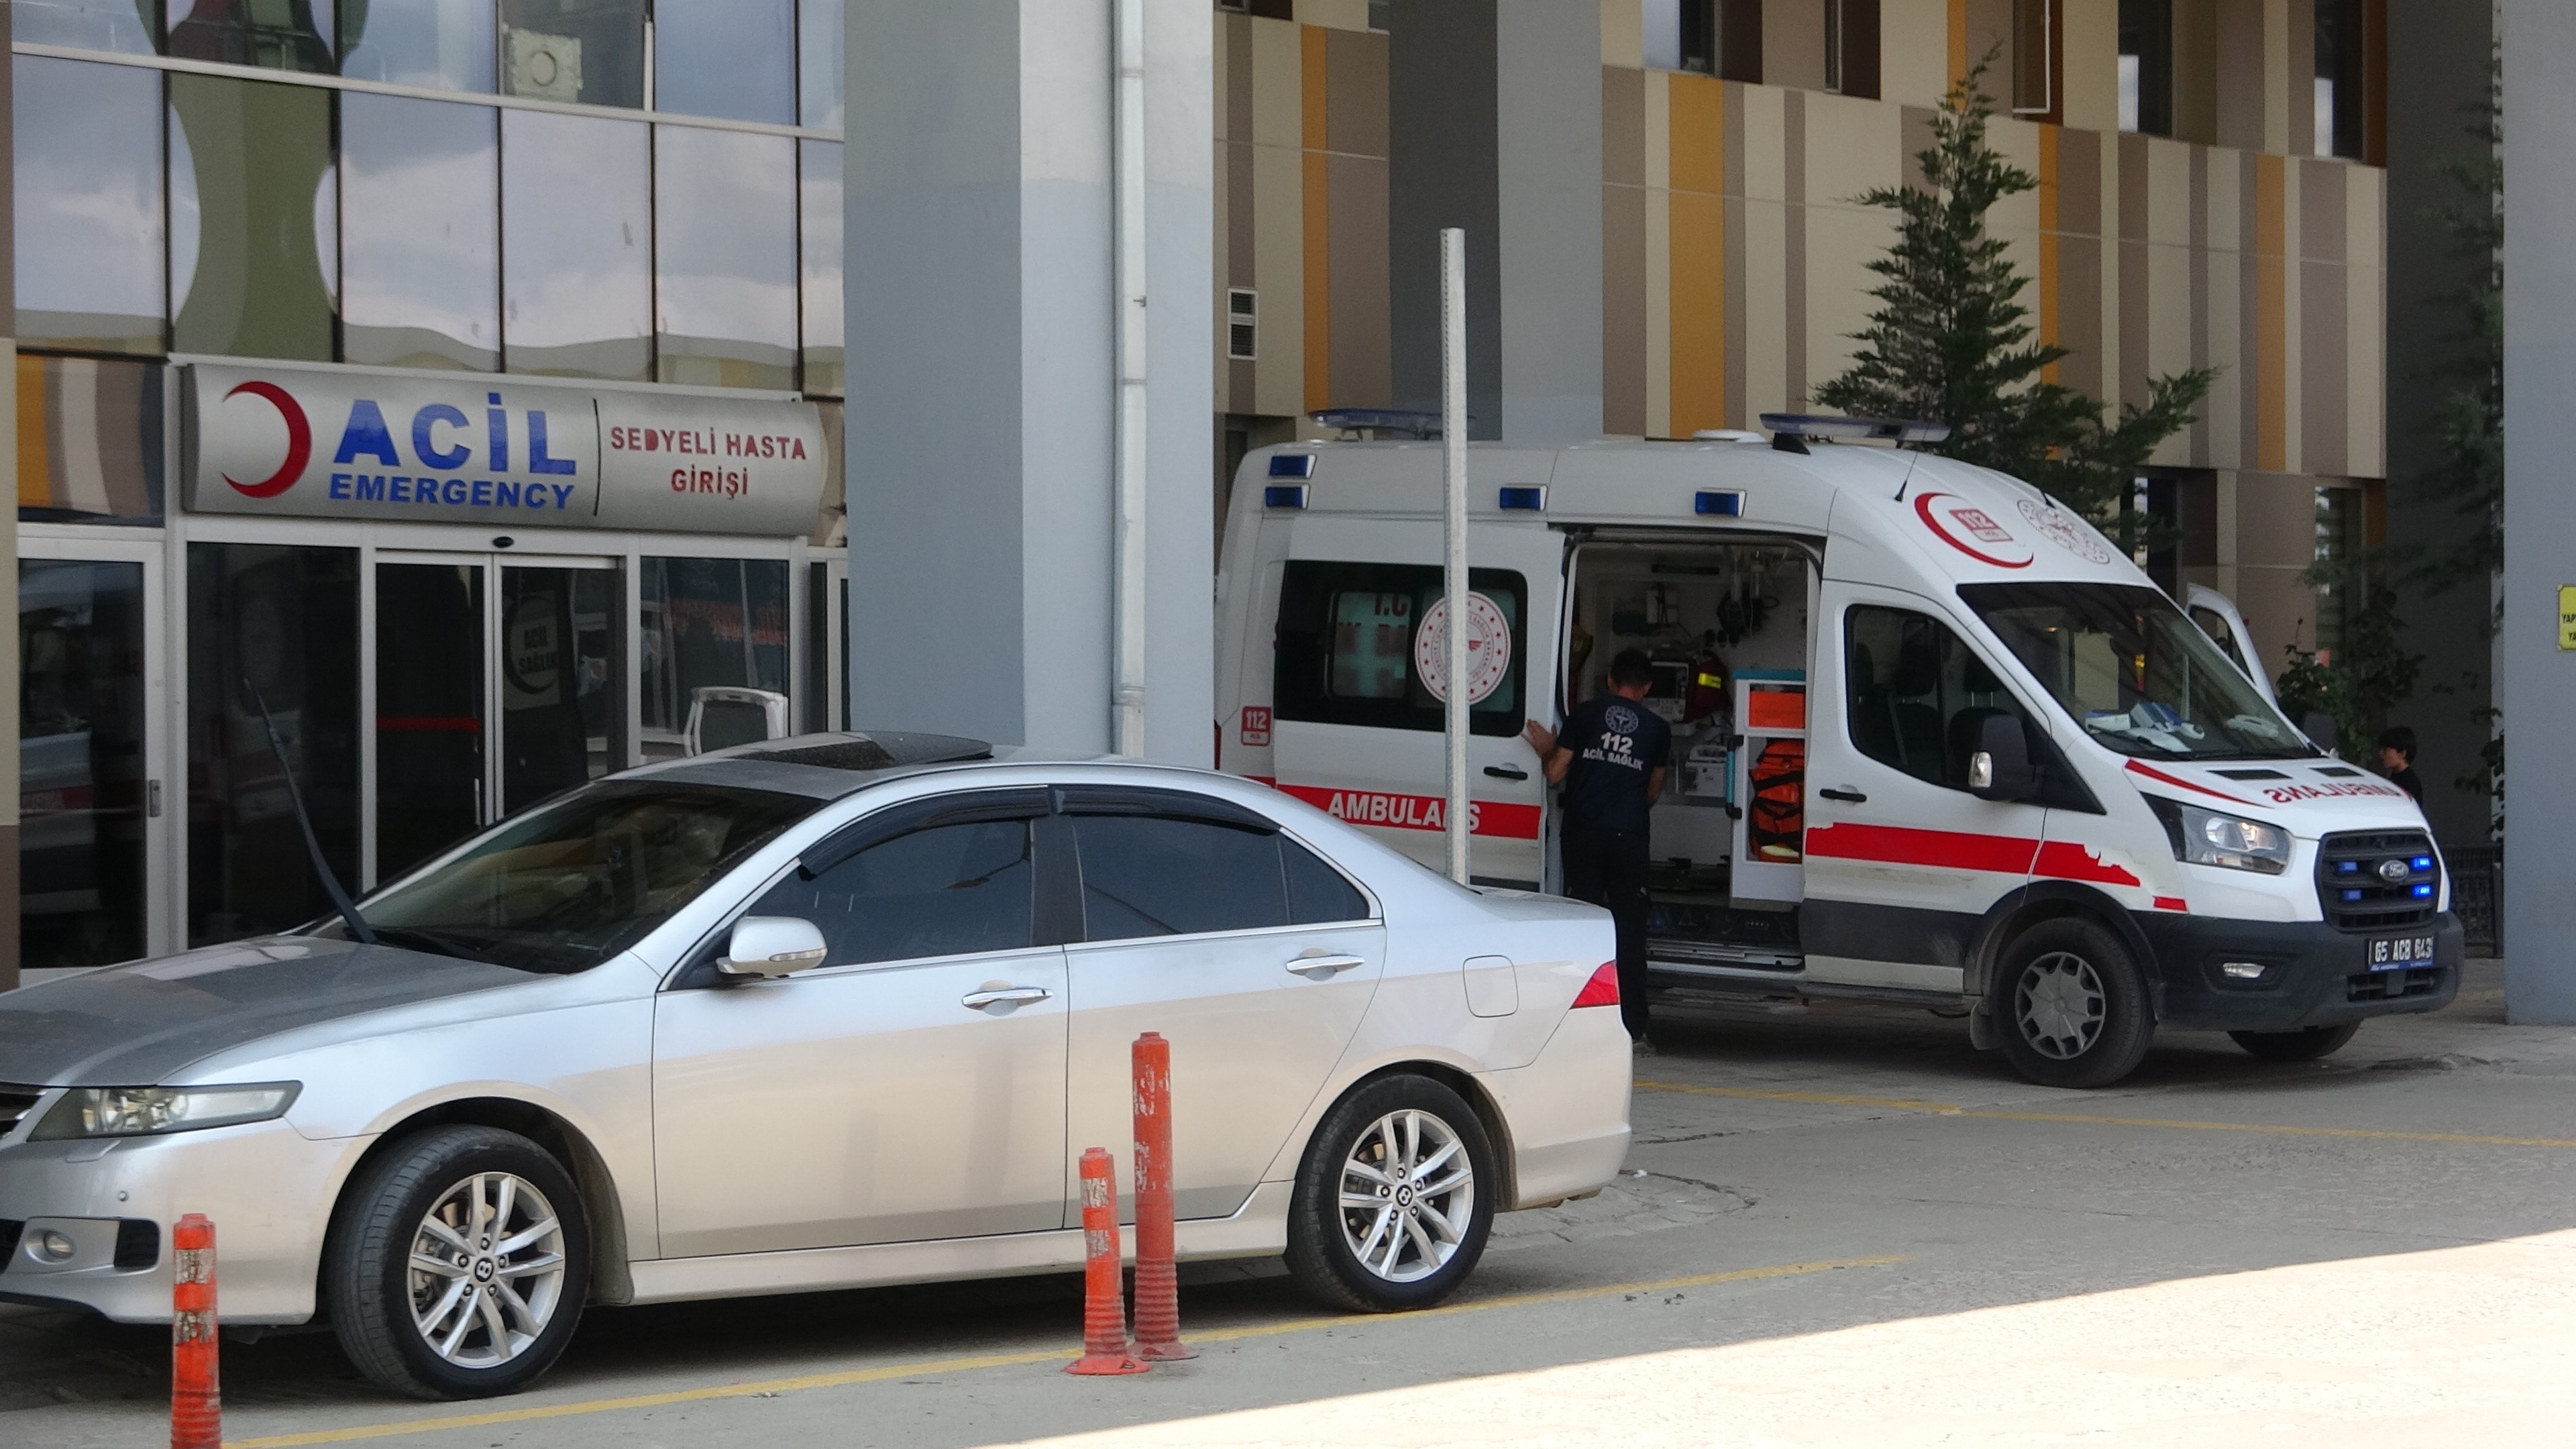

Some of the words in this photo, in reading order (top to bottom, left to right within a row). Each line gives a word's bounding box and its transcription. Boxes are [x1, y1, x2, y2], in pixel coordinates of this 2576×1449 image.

[333, 392, 576, 476] ACİL
[610, 425, 716, 455] SEDYELİ
[726, 433, 806, 460] HASTA
[329, 474, 574, 509] EMERGENCY
[671, 464, 748, 500] GİRİŞİ
[1957, 512, 1995, 529] 112
[1246, 711, 1267, 729] 112
[1601, 731, 1633, 755] 112
[1582, 747, 1605, 761] ACİL
[1607, 752, 1644, 771] SAĞLIK
[1328, 792, 1481, 831] AMBULAS
[2375, 941, 2388, 963] 65
[2393, 938, 2411, 961] ACB
[2415, 937, 2431, 959] 643
